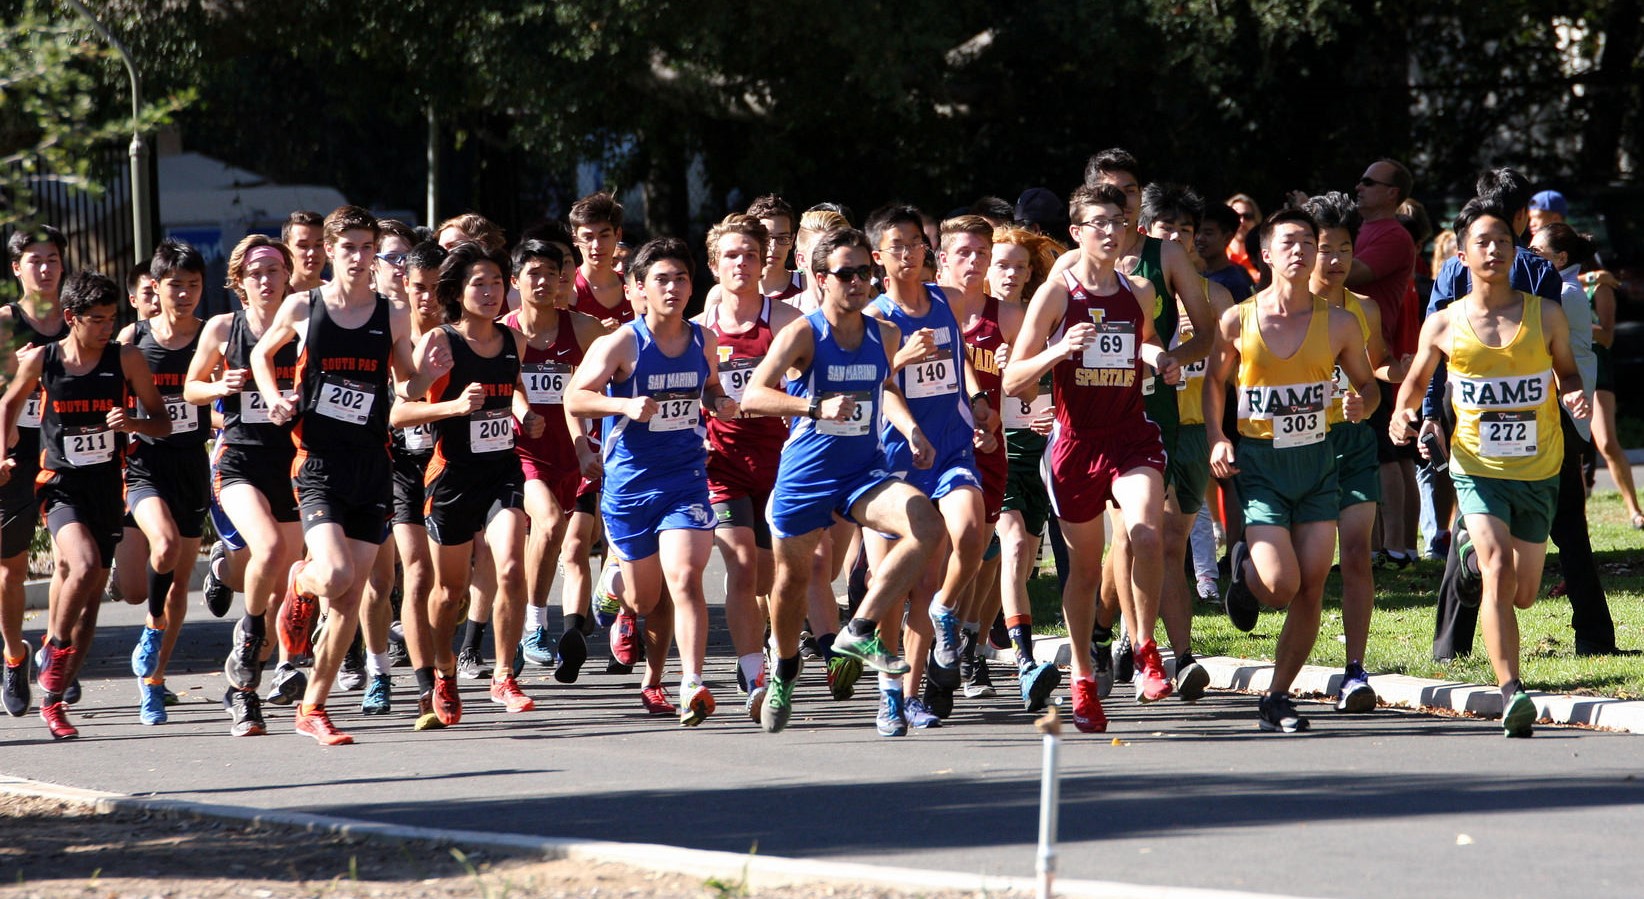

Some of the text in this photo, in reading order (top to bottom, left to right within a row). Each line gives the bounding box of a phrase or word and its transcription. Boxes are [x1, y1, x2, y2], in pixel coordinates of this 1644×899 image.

[1088, 308, 1106, 323] T
[1100, 335, 1123, 353] 69
[276, 366, 295, 379] PAS
[321, 357, 378, 372] SOUTH PAS
[828, 364, 877, 381] SAN MARINO
[916, 362, 946, 384] 140
[152, 373, 179, 386] OUTH
[530, 375, 563, 391] 106
[648, 371, 698, 390] SAN MARINO
[1075, 367, 1137, 387] SPARTANS
[329, 387, 364, 409] 202
[1246, 384, 1324, 413] RAMS
[1460, 378, 1542, 406] RAMS
[53, 400, 89, 413] SOUTH
[92, 399, 114, 412] PAS
[167, 404, 188, 420] 81
[661, 401, 692, 418] 137
[480, 419, 509, 438] 200
[1283, 414, 1317, 433] 303
[1490, 423, 1527, 441] 272
[74, 434, 106, 452] 211
